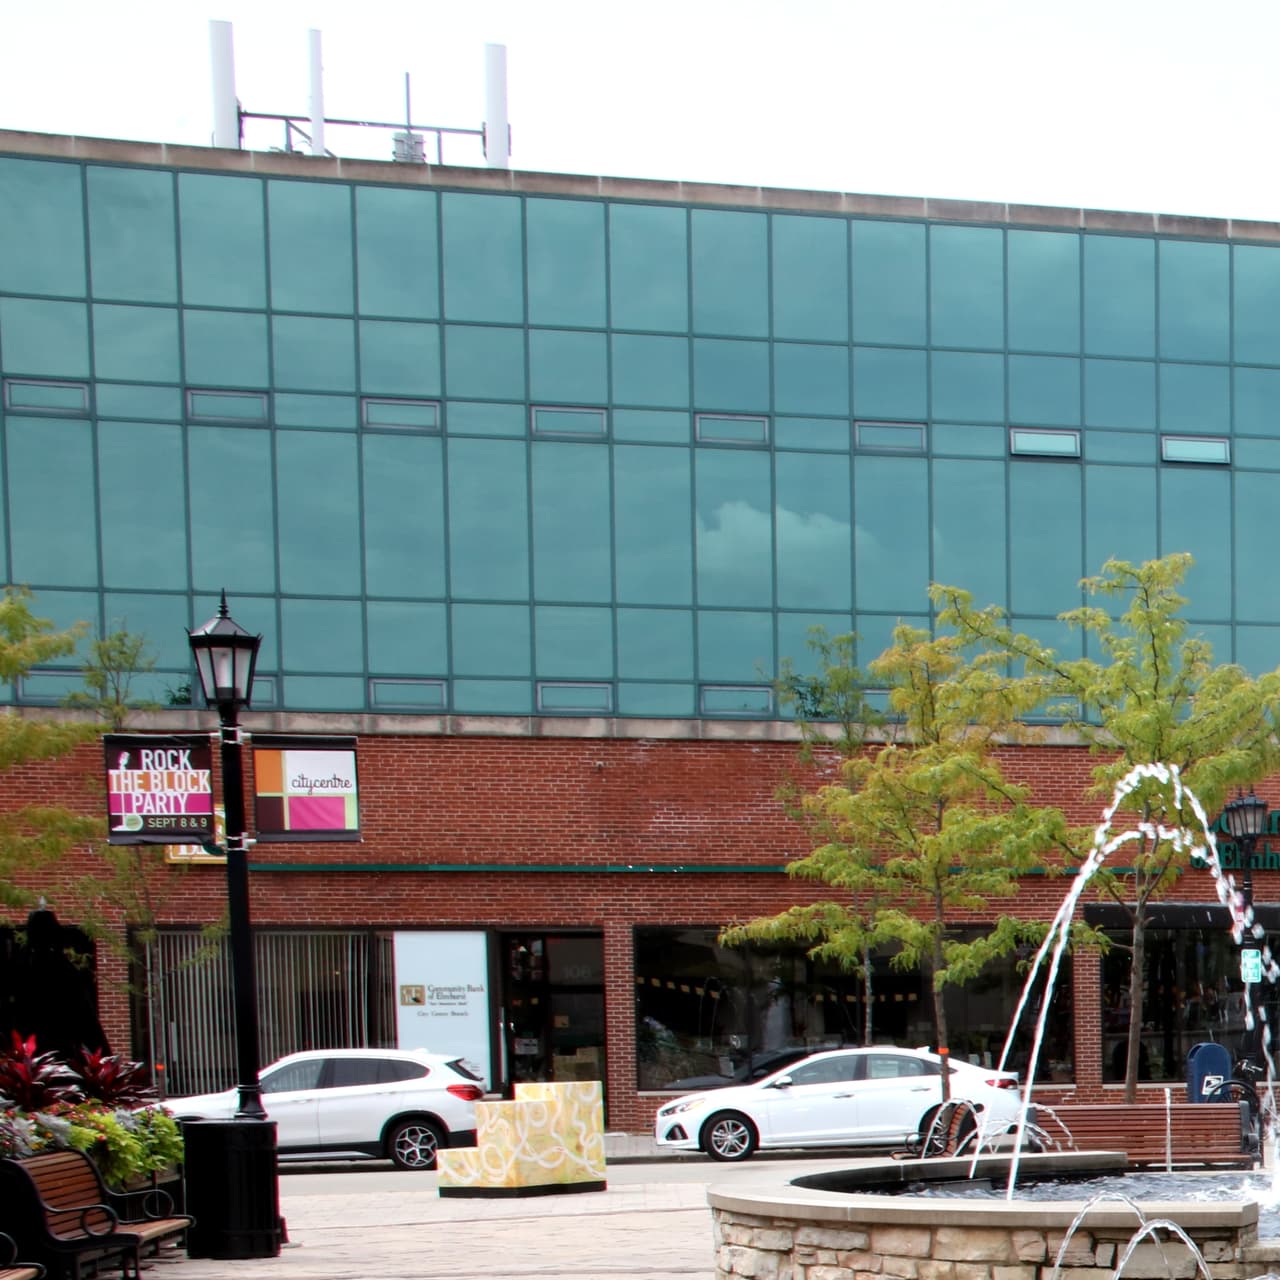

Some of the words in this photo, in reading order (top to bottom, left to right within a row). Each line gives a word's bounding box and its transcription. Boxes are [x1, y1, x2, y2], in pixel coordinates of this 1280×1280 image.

[141, 749, 192, 771] ROCK
[110, 770, 144, 792] THE
[151, 771, 212, 793] BLOCK
[291, 774, 352, 796] citycentre
[132, 792, 188, 814] PARTY
[148, 817, 177, 828] SEPT
[180, 818, 188, 829] 8
[190, 818, 201, 828] &
[201, 818, 208, 828] 9
